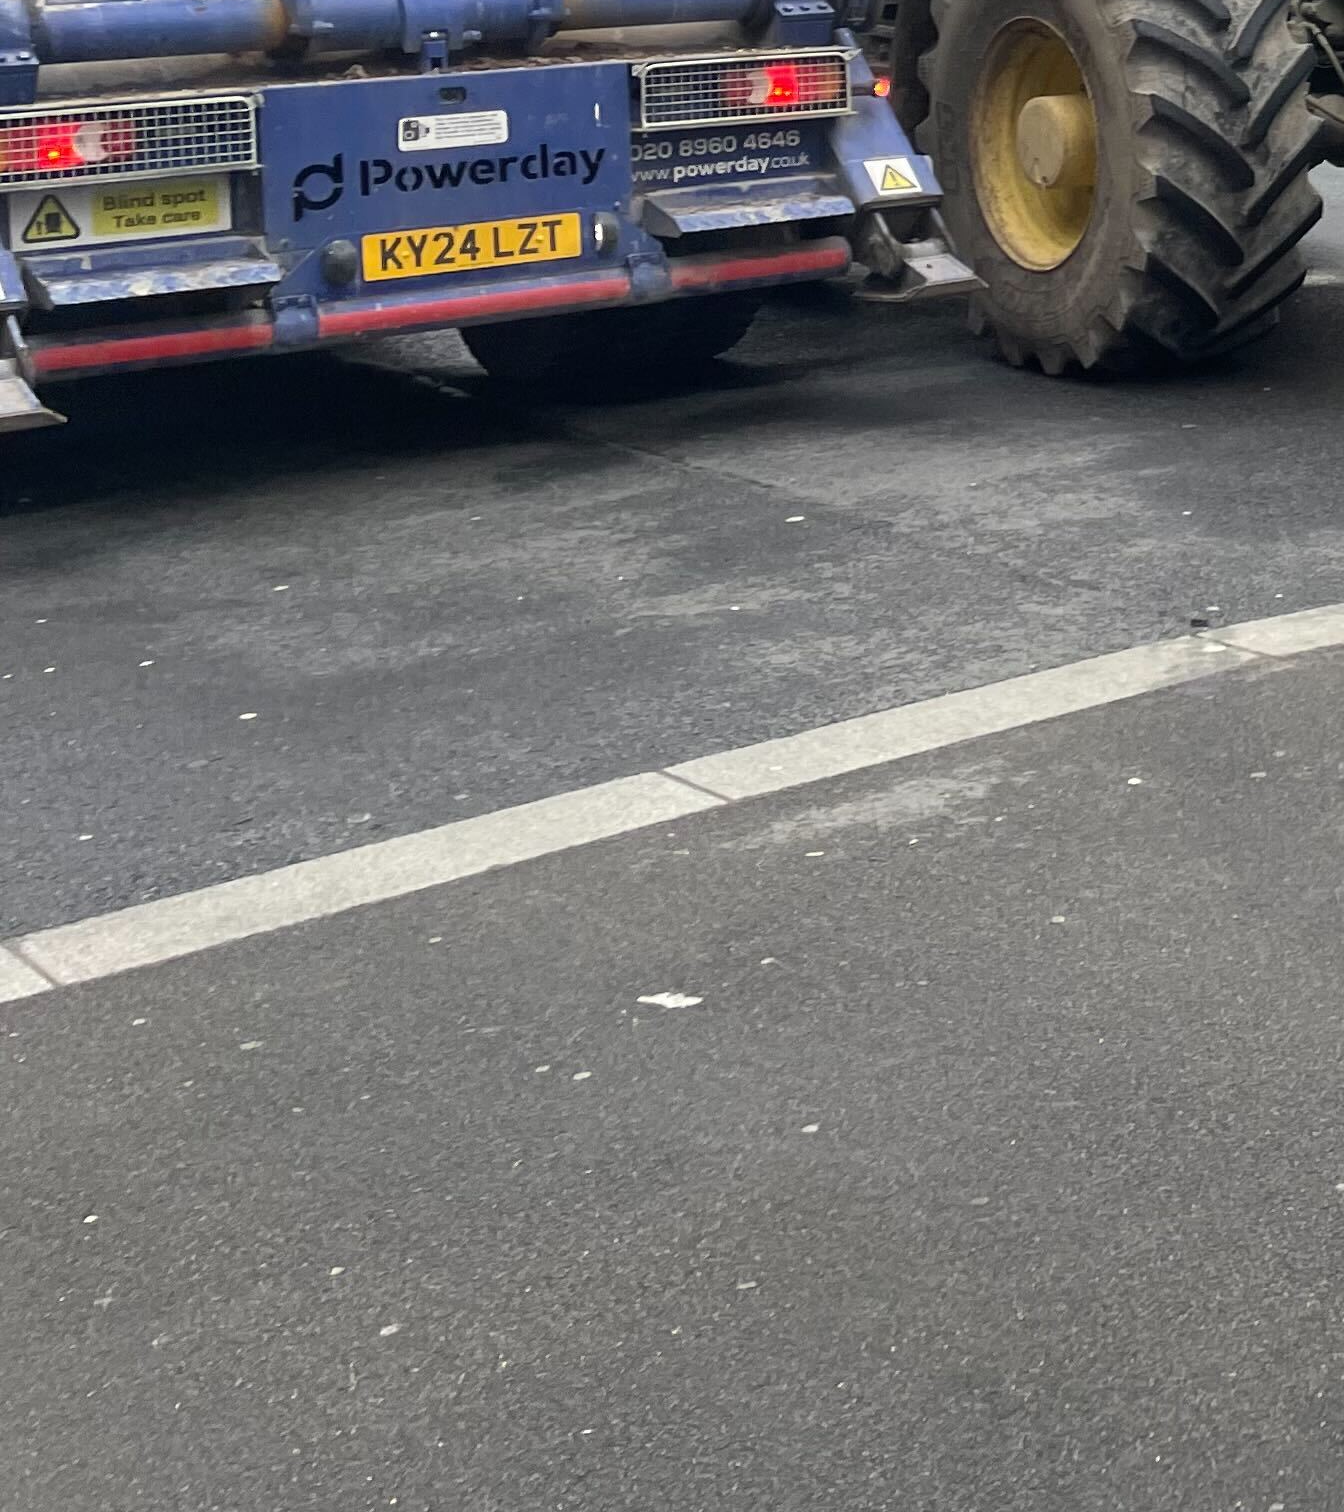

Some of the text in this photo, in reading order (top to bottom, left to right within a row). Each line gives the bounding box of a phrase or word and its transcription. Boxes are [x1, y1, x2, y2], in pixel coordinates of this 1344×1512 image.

[679, 135, 737, 156] 8960
[743, 130, 801, 150] 4646
[360, 143, 605, 196] Powerday
[103, 189, 206, 211] Blind spot
[113, 210, 200, 229] Take care
[380, 219, 562, 271] KY24 LZT
